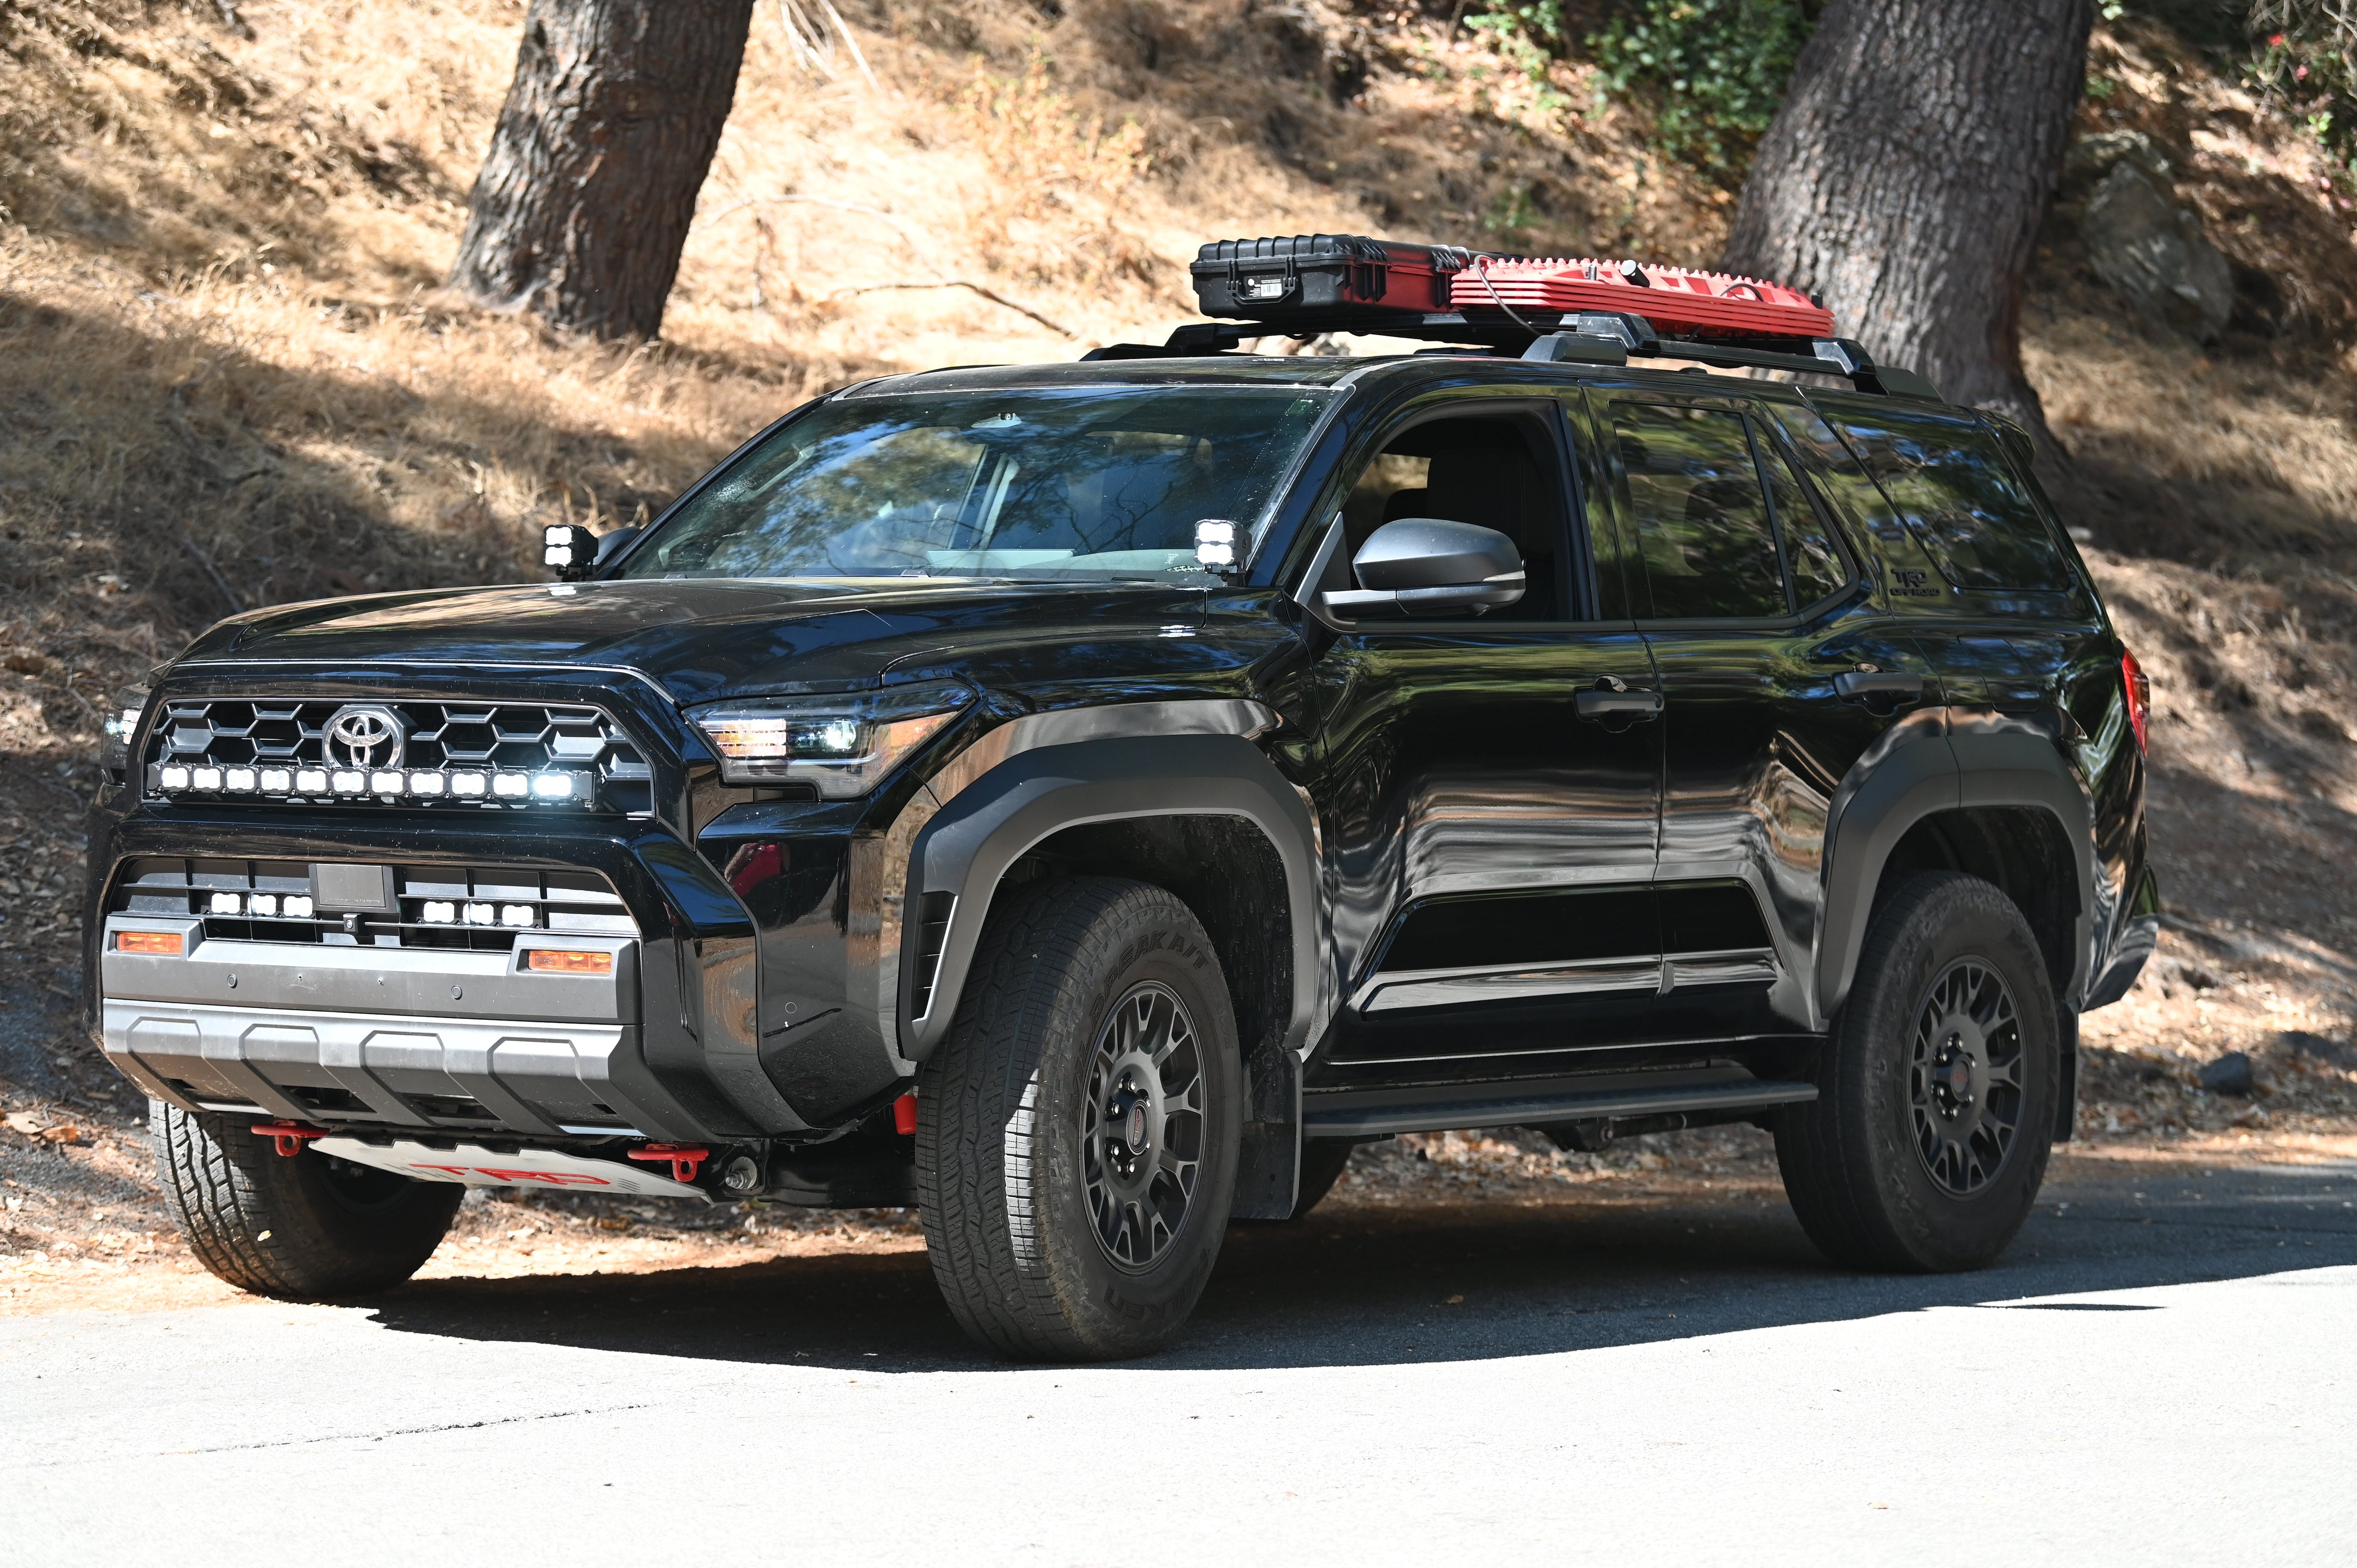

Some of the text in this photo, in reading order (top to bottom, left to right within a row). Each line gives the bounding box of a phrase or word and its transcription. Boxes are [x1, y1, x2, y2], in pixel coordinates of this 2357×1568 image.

[1890, 568, 1928, 587] TRD
[409, 1163, 611, 1185] TRD
[1104, 1248, 1212, 1320] FALKEN
